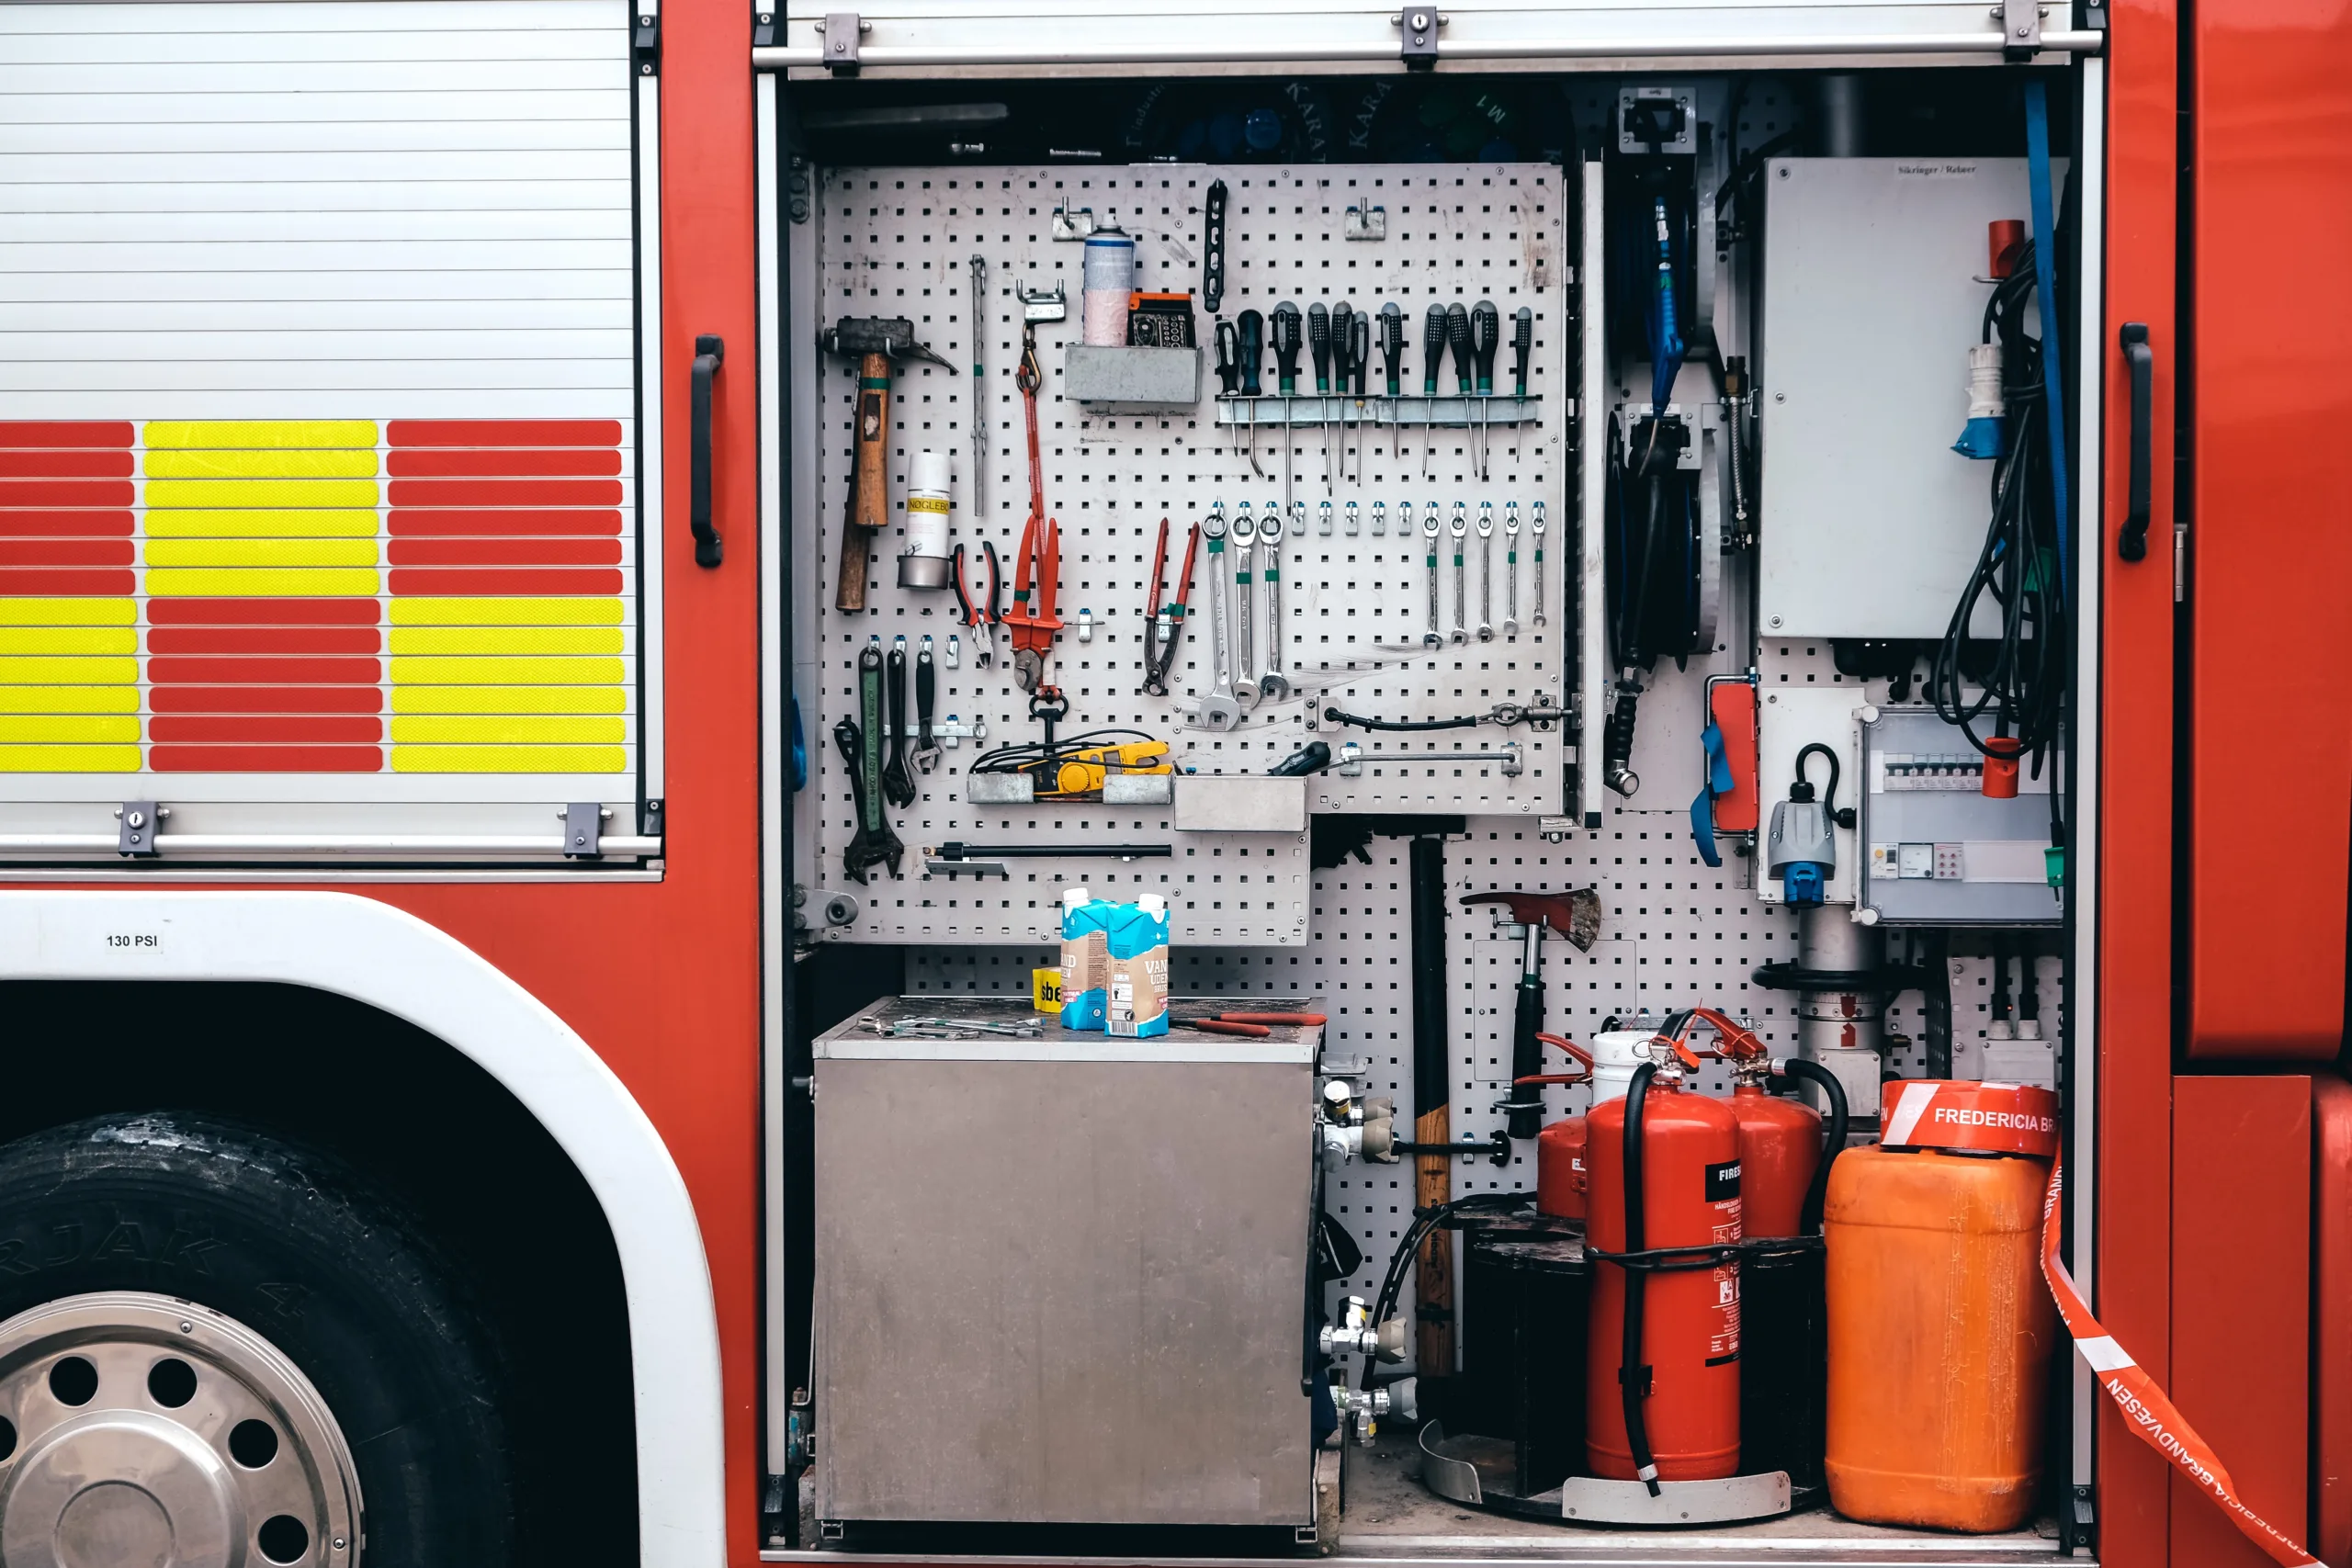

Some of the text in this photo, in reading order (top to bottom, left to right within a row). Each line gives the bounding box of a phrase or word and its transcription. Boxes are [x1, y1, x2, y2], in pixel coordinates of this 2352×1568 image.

[107, 935, 157, 947] 130 PSI
[1934, 1108, 2039, 1131] FREDERICIA
[2106, 1378, 2214, 1486] BRANDVÆSEN
